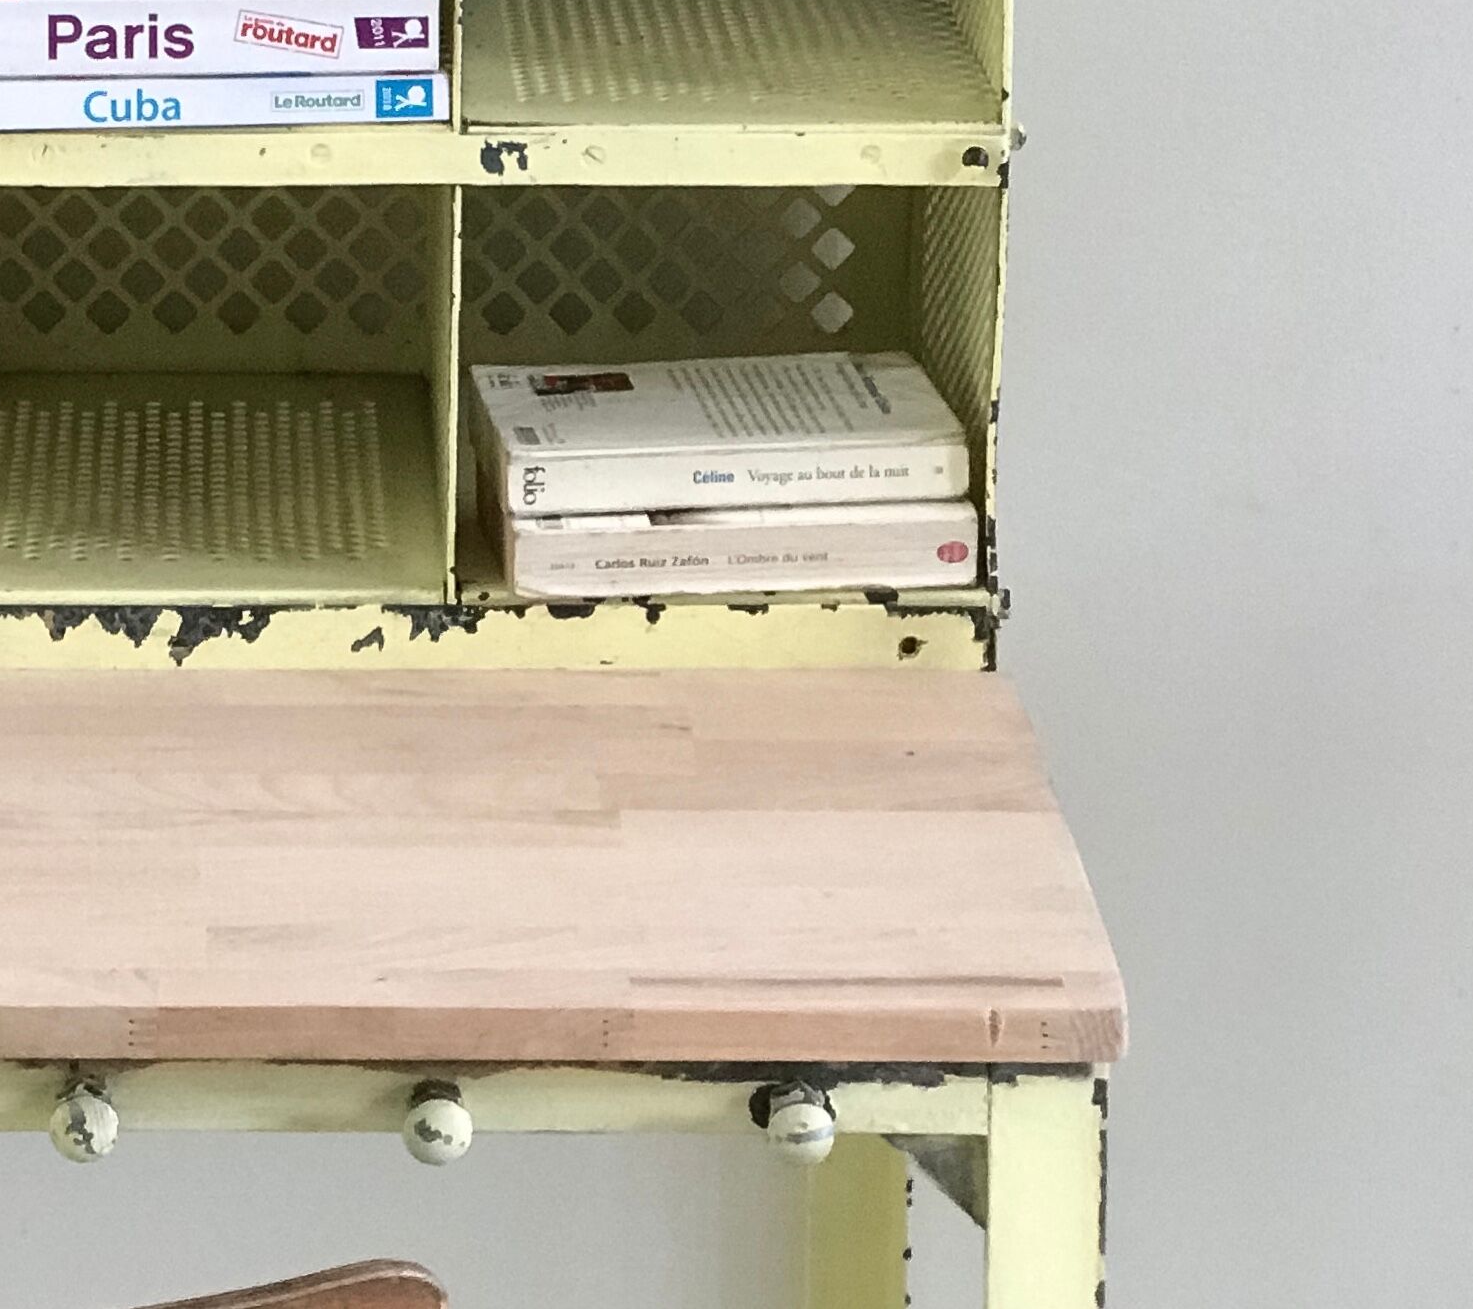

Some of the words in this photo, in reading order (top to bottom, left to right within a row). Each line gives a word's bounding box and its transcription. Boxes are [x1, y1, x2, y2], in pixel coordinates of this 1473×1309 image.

[47, 13, 195, 60] Paris
[240, 21, 337, 53] routard
[370, 18, 385, 47] 2011
[83, 88, 181, 123] Cuba
[274, 95, 292, 109] Le
[294, 94, 361, 108] Routard
[523, 465, 546, 506] folio
[693, 470, 735, 484] Céline
[747, 469, 794, 486] Voyage
[797, 469, 814, 481] au
[816, 466, 845, 481] bout
[849, 466, 865, 479] de
[868, 465, 880, 478] la
[883, 466, 909, 478] nuit
[595, 559, 635, 570] Carlos
[639, 558, 667, 568] Ruiz
[672, 555, 709, 567] Zafón
[782, 553, 798, 563] du
[802, 552, 829, 562] vent
